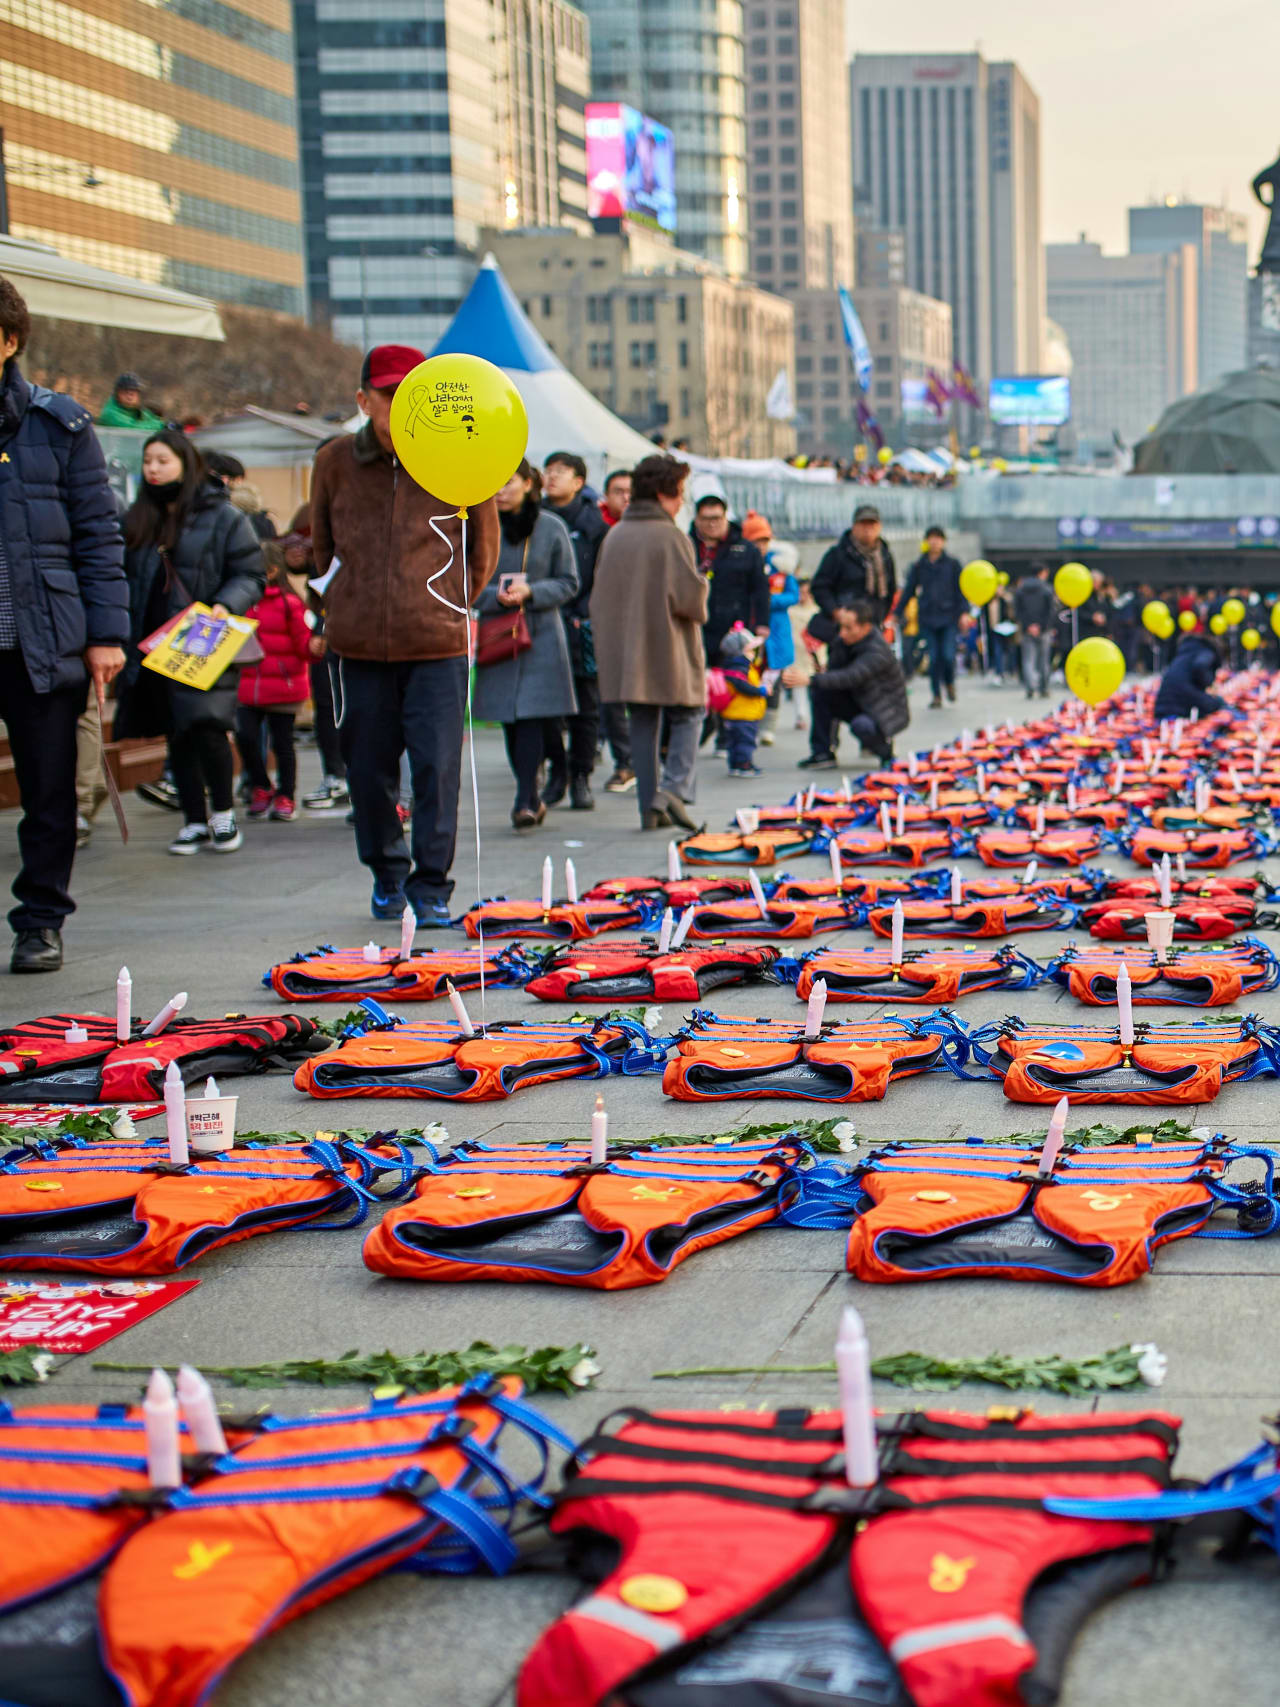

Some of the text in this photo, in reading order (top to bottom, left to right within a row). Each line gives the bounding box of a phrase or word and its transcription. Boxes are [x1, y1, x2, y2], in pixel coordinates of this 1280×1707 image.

[435, 382, 469, 392] 안전한
[429, 393, 473, 403] 나라에서
[432, 404, 474, 418] 살고 싶어요
